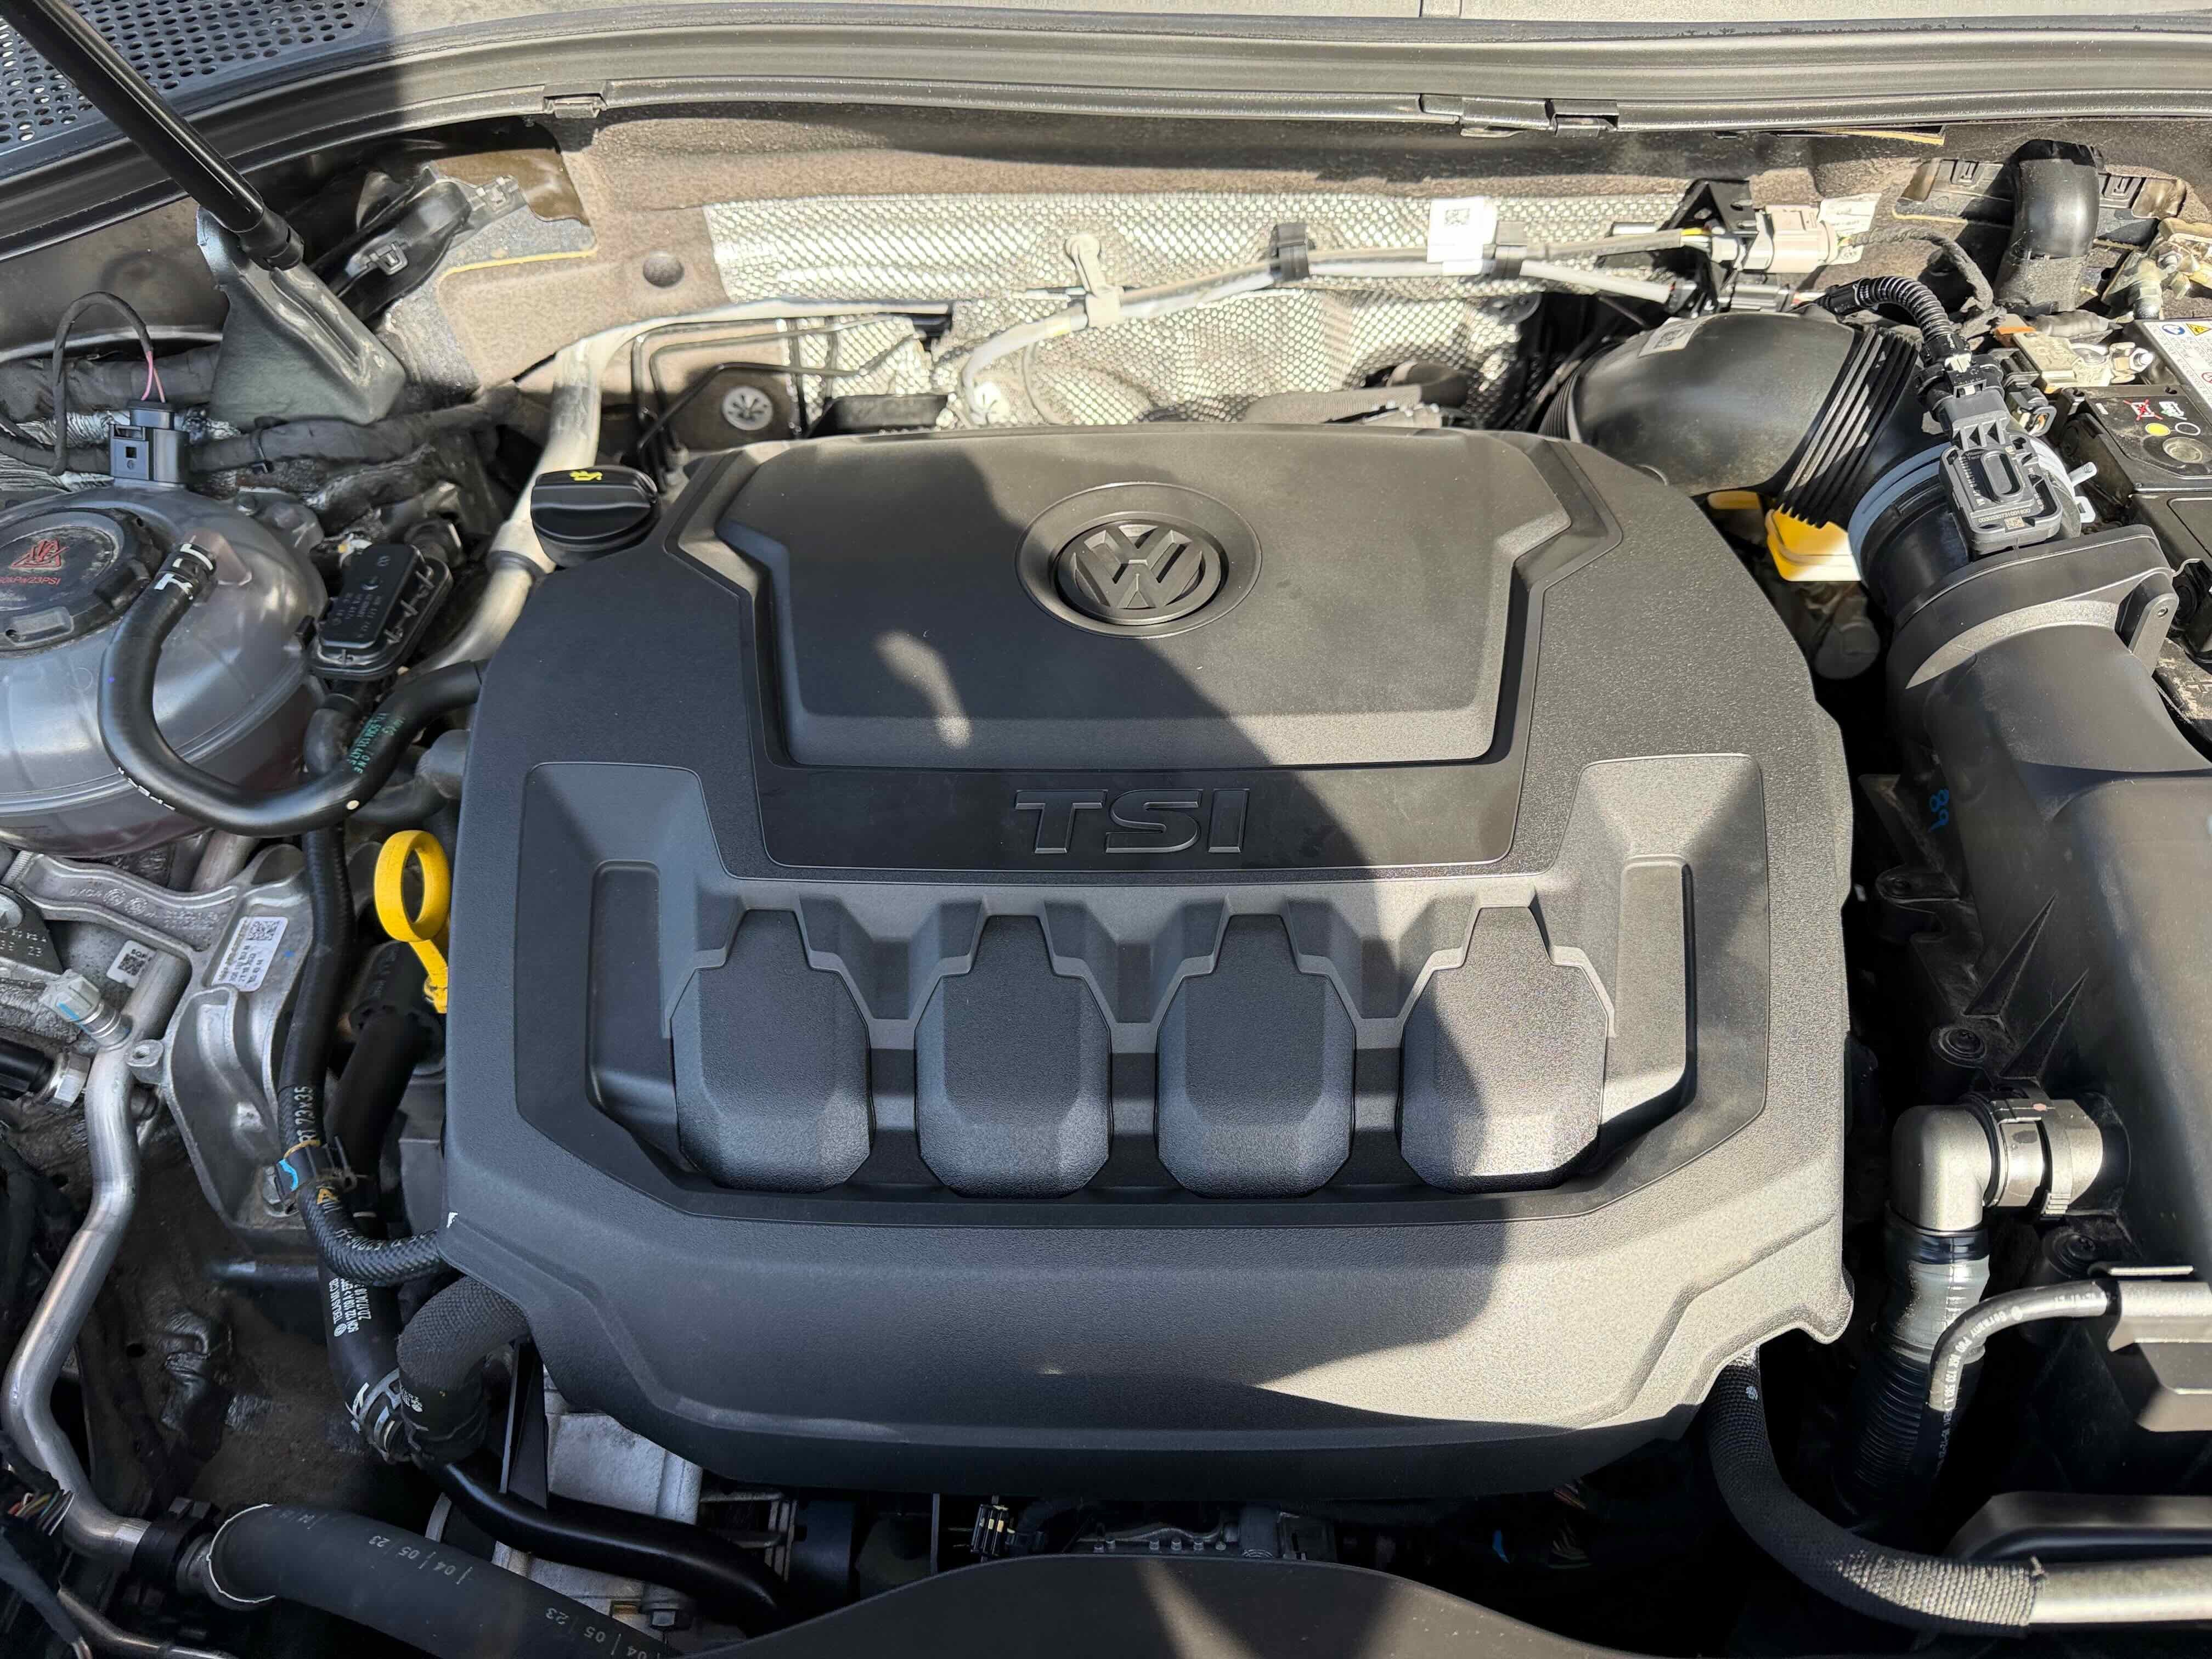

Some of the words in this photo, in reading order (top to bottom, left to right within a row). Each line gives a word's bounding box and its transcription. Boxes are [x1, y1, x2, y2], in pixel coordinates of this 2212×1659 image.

[1015, 788, 1251, 854] TSI
[368, 1535, 392, 1548] 23
[397, 1546, 421, 1560] 05
[546, 1607, 570, 1625] 23
[583, 1626, 607, 1643] 05
